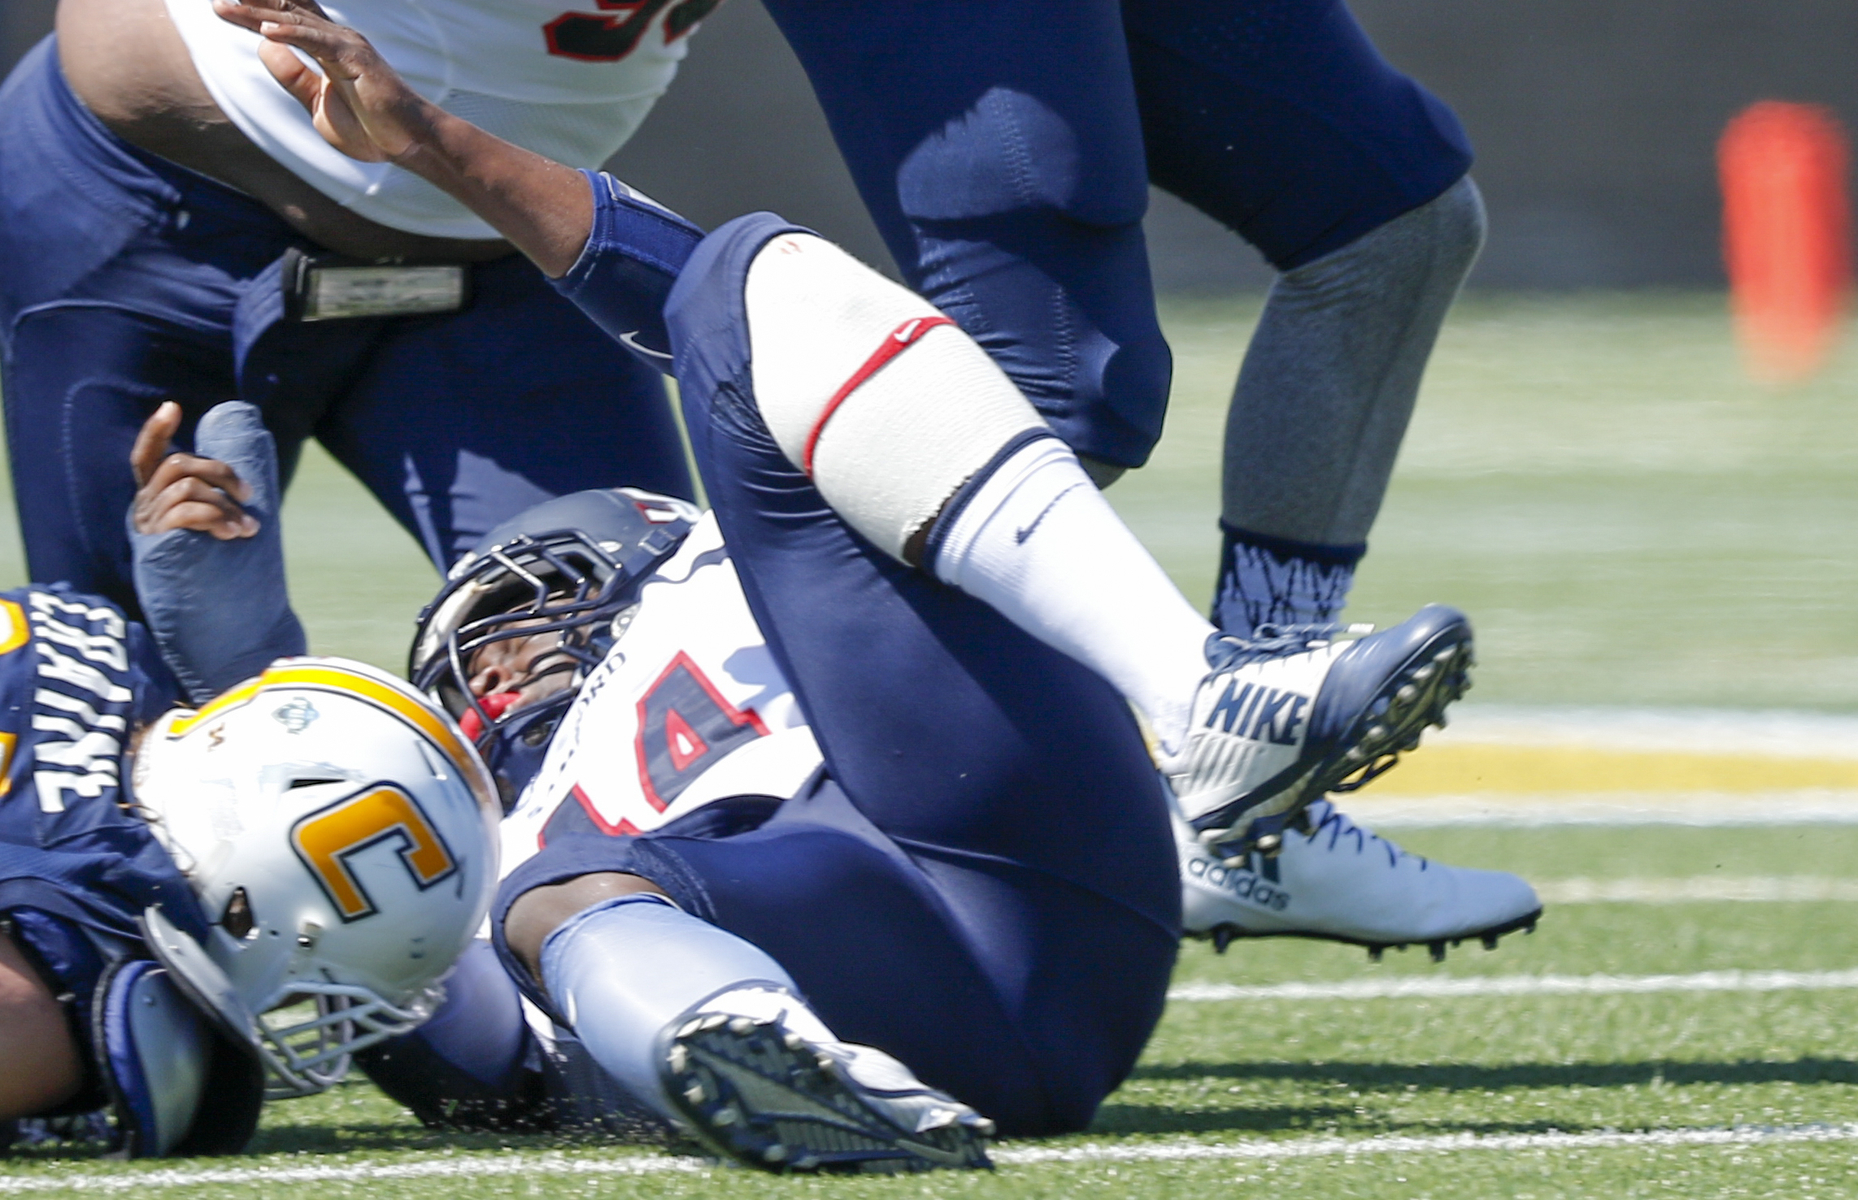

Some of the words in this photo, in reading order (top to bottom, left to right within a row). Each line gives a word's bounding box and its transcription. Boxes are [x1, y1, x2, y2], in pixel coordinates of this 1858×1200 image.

[28, 590, 133, 813] CRAINE
[1205, 678, 1310, 746] NIKE
[290, 781, 457, 925] C
[1188, 856, 1292, 912] adidas
